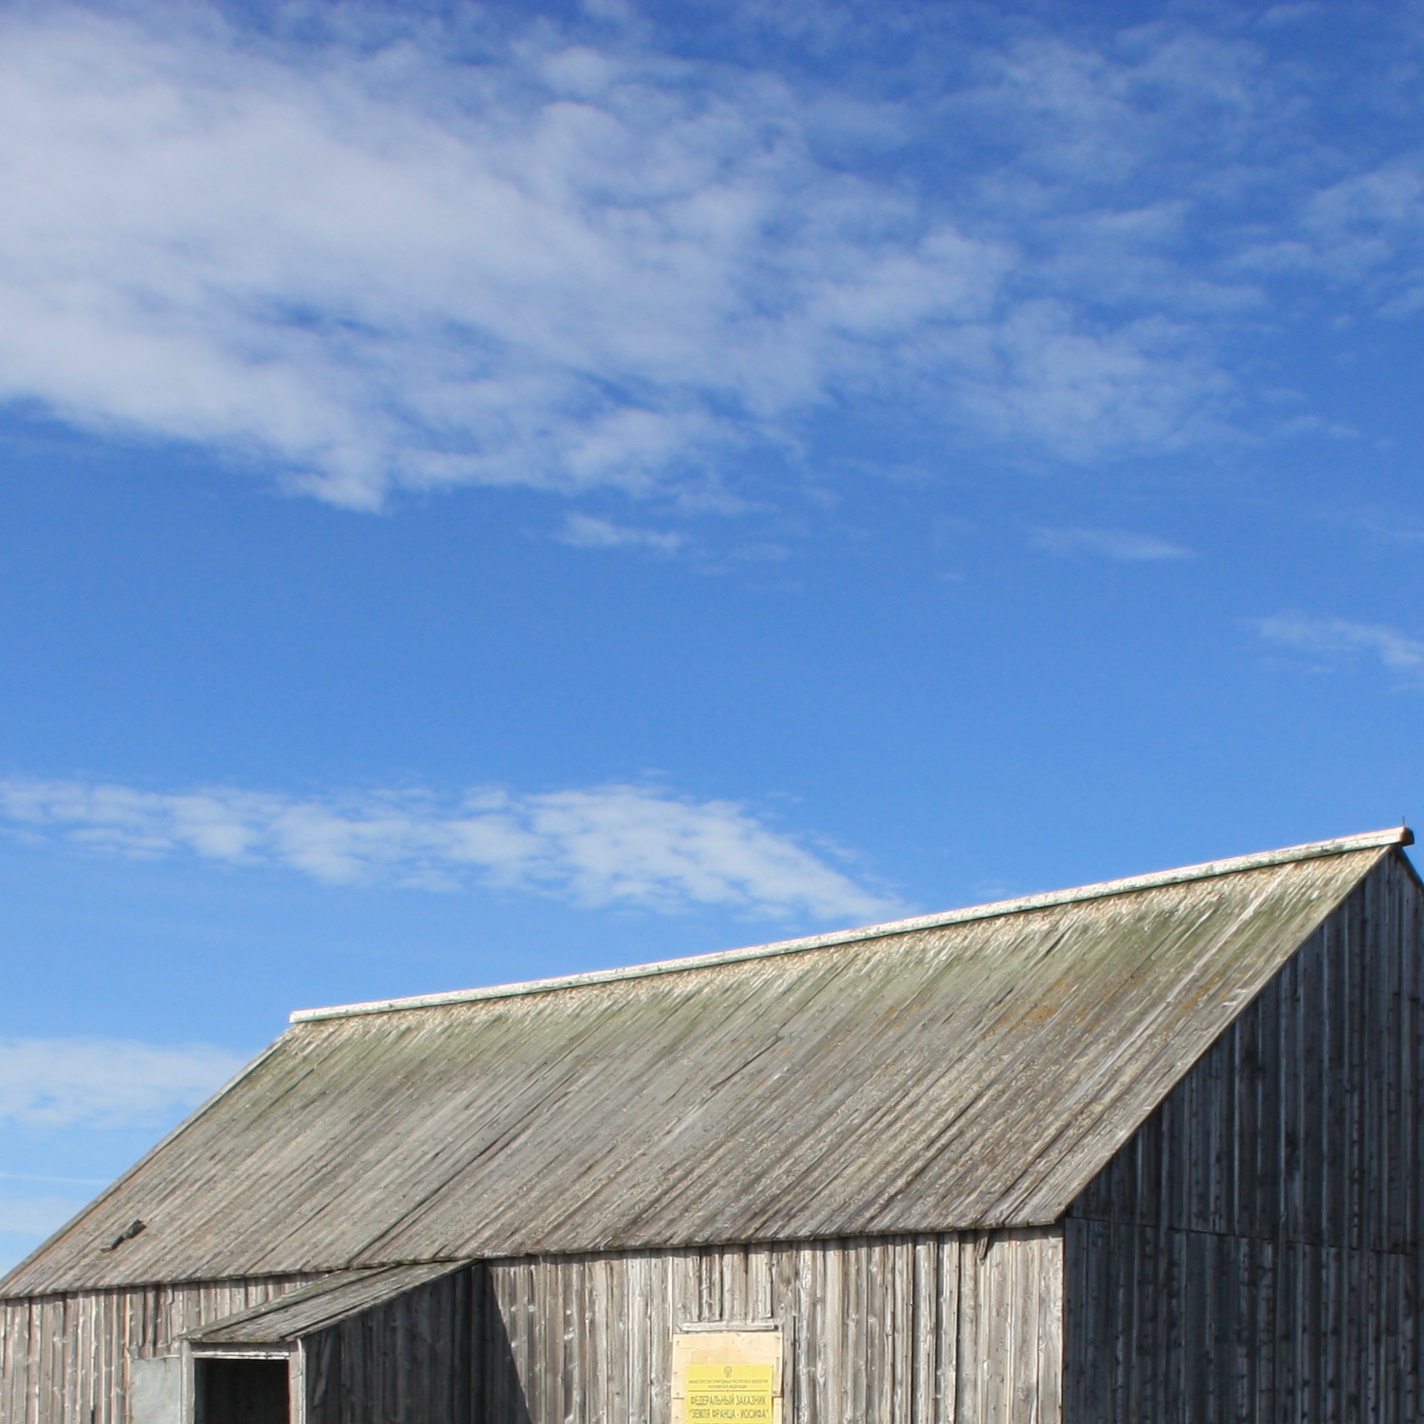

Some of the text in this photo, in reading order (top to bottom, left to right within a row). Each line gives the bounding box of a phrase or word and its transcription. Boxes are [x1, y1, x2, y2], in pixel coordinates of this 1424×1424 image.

[690, 1394, 766, 1405] ФЕДЕРАЛЬНЫЙ ЗАКАЗНИК
[712, 1409, 736, 1419] ФРАНЦА
